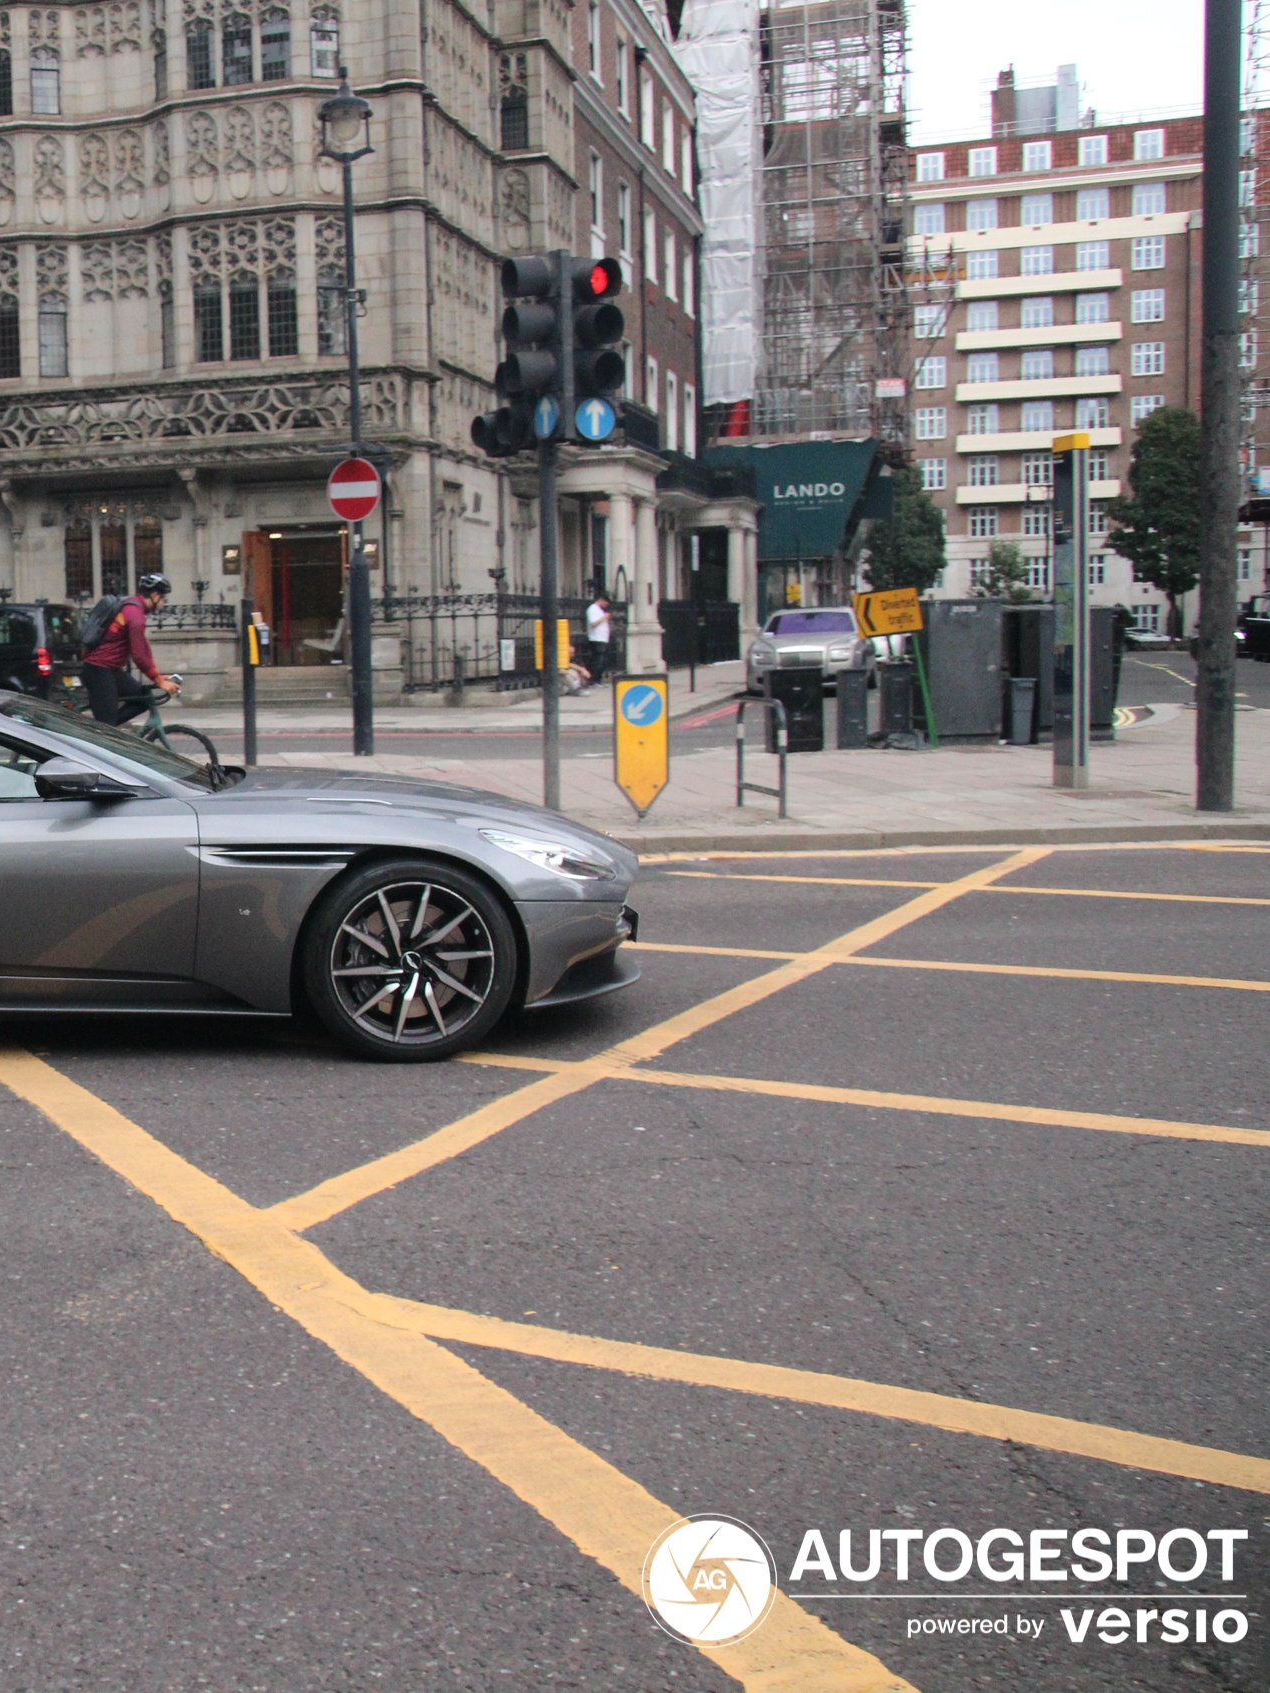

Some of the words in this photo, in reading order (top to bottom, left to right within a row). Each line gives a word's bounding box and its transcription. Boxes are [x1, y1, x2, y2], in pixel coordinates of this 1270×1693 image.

[773, 482, 845, 498] LANDO
[880, 597, 916, 611] Diverted
[887, 612, 915, 625] traffic
